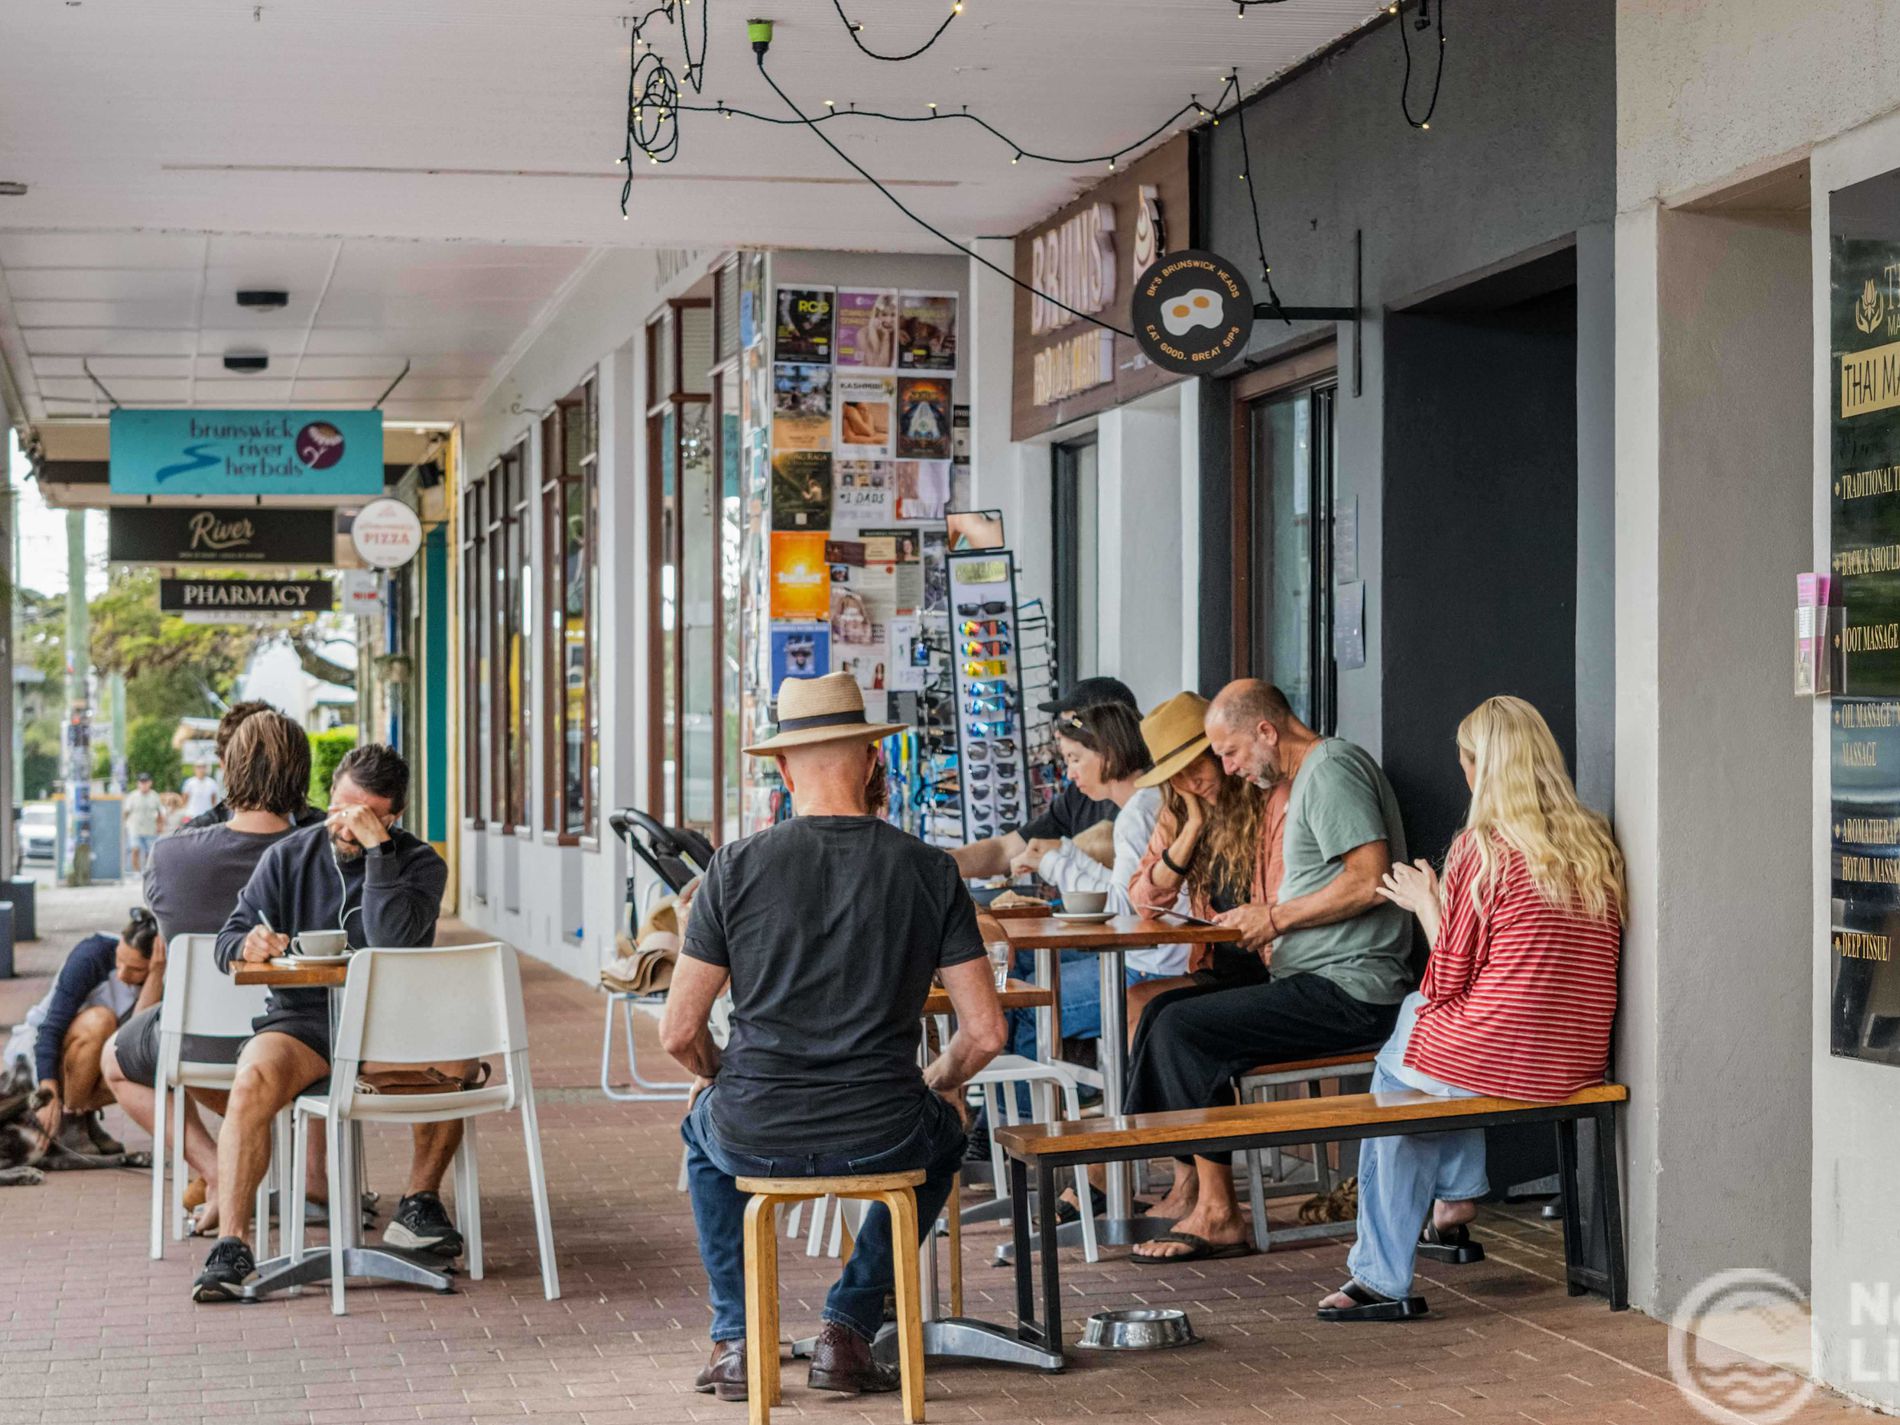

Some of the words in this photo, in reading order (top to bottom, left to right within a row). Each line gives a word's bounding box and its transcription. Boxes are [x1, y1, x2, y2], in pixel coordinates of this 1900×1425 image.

[1146, 276, 1162, 297] BK'S
[1162, 260, 1216, 277] BRUNSWICK
[1217, 269, 1240, 298] HEADS
[1146, 324, 1160, 341] EAT
[1160, 342, 1187, 360] GOOD.
[1191, 346, 1221, 361] GREAT
[1222, 326, 1240, 347] SIPS
[1844, 358, 1876, 407] THAI
[189, 417, 294, 439] brunswick
[238, 439, 284, 457] river
[225, 457, 303, 477] herbals
[1842, 467, 1892, 500] TRADITIONAL
[188, 510, 255, 550] River
[364, 532, 410, 545] PIZZA
[1842, 549, 1862, 577] BACK
[1863, 548, 1870, 574] &
[183, 585, 311, 606] PHARMACY
[1842, 626, 1862, 653] FOOT
[1863, 623, 1899, 651] MASSAGE
[1842, 703, 1855, 728] OIL
[1856, 702, 1891, 728] MASSAGE
[1842, 741, 1877, 767] MASSAGE
[1842, 856, 1858, 881] HOT
[1860, 856, 1872, 882] OIL
[1842, 932, 1861, 958] DEEP
[1861, 934, 1887, 961] TISSUE
